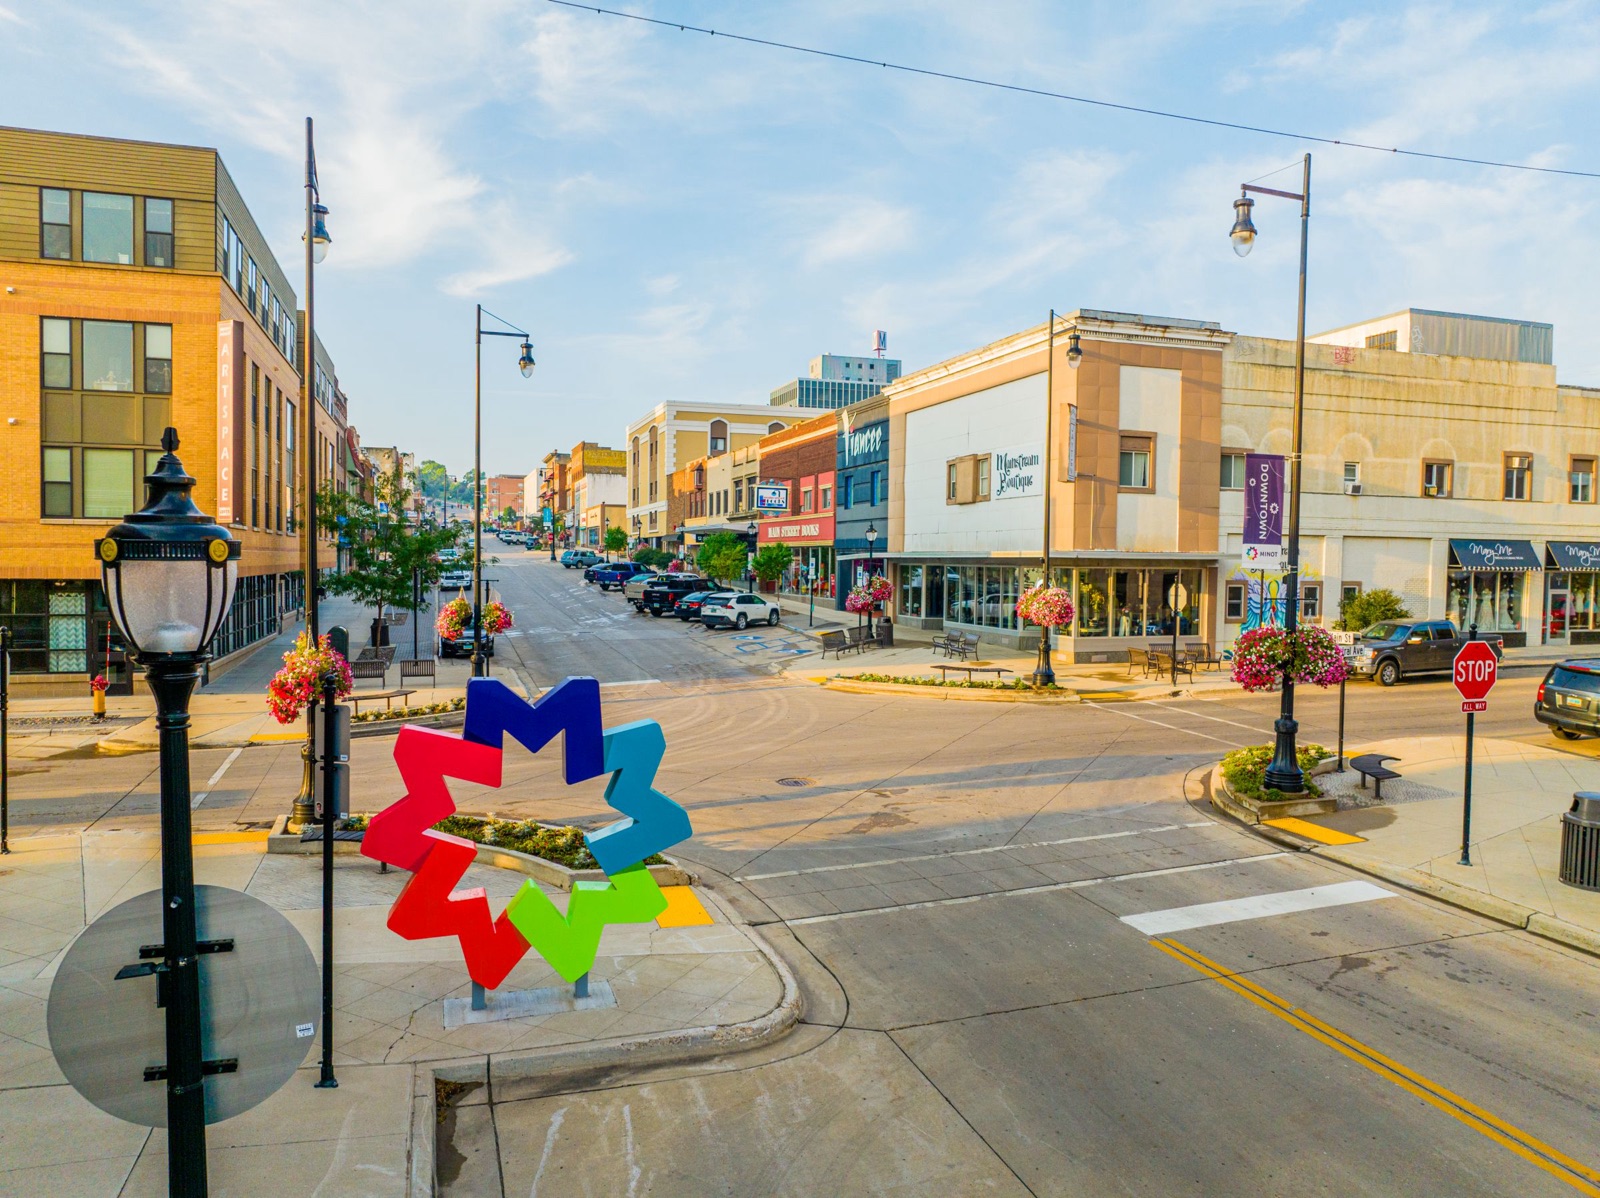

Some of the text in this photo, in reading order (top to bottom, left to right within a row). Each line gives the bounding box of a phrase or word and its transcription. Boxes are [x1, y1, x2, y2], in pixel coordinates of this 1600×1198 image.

[221, 343, 230, 501] ARTSPACE
[996, 453, 1039, 476] Mainstream
[996, 472, 1033, 496] Boutique
[1259, 463, 1269, 540] DOWNTOWN
[768, 524, 819, 538] MAIN STREET BOOKS
[1589, 546, 1600, 557] M
[1344, 633, 1351, 643] St
[1353, 646, 1363, 655] Ave
[1456, 660, 1494, 682] STOP
